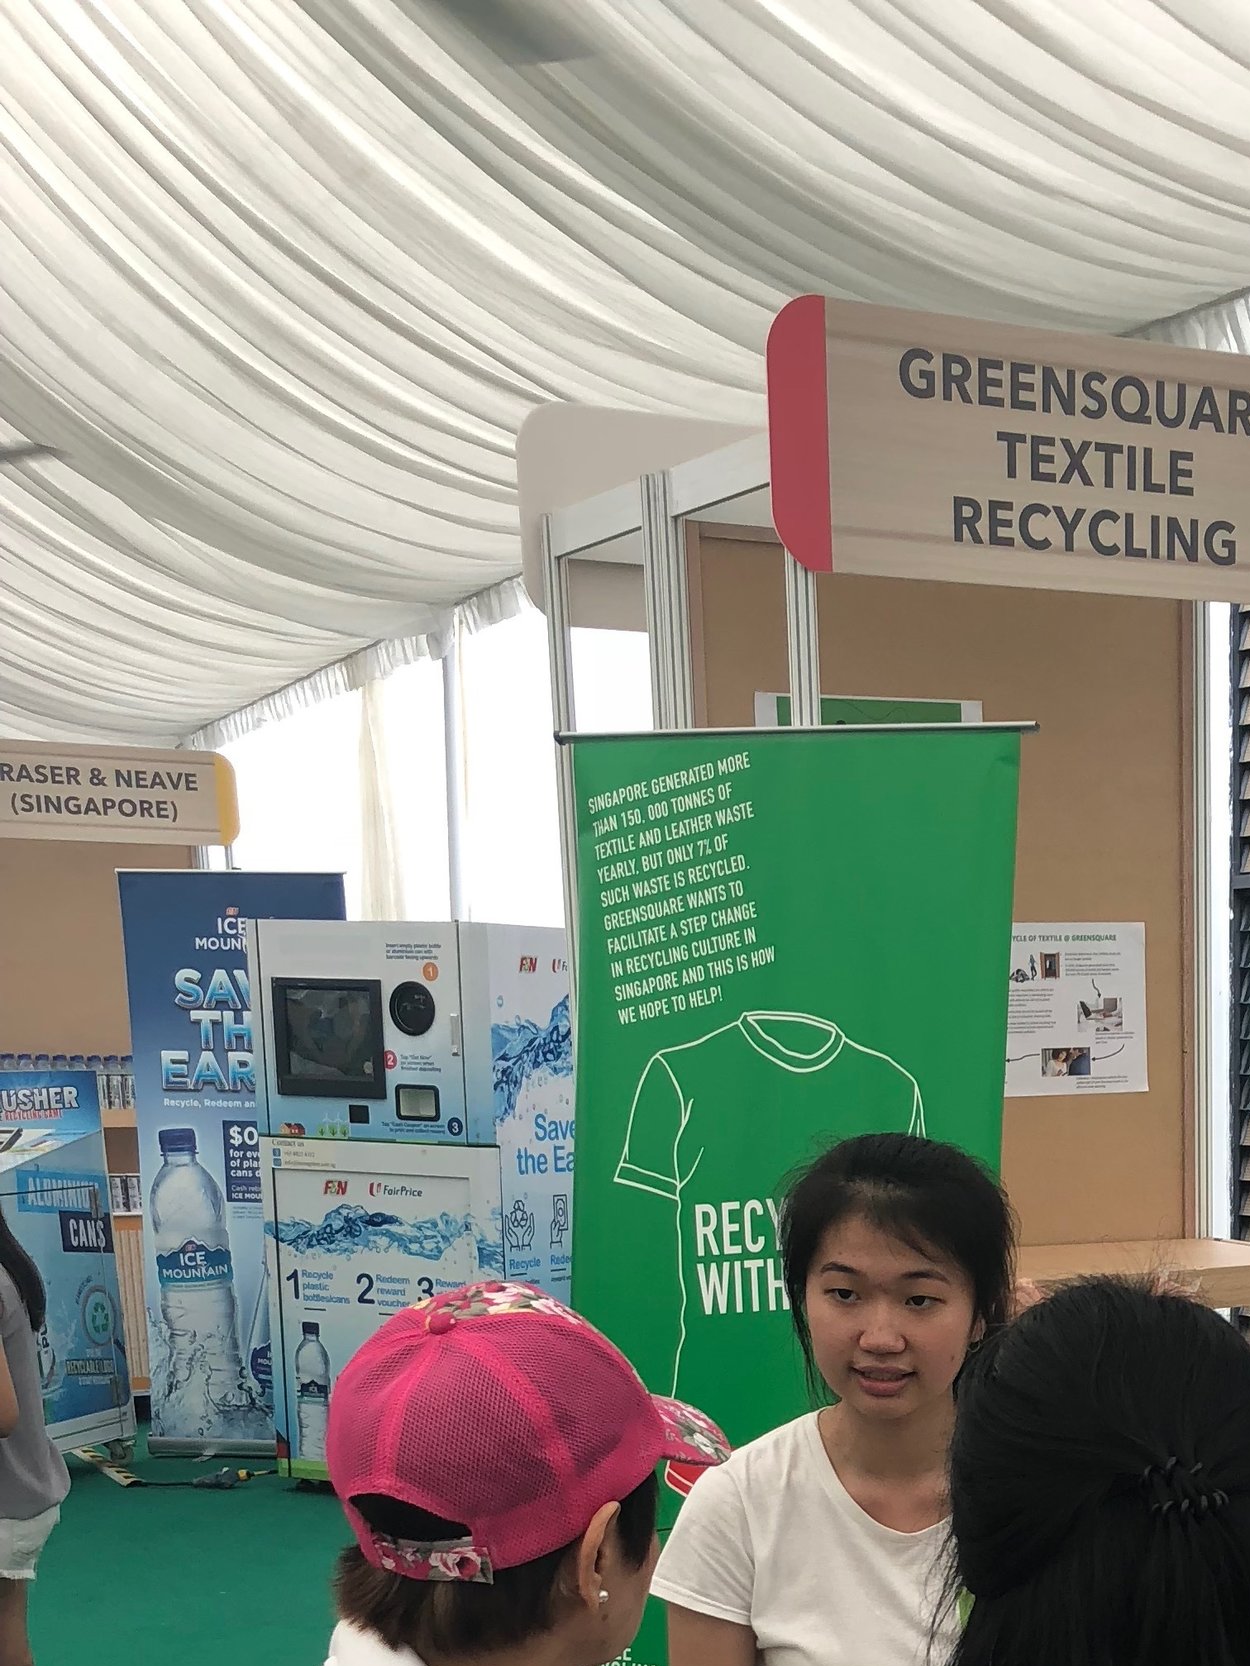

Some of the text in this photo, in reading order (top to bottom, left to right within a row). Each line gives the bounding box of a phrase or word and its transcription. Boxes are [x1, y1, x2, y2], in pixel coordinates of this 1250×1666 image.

[996, 431, 1195, 498] TEXTILE
[953, 495, 1238, 567] RECYCLING
[89, 767, 108, 787] &
[115, 769, 199, 792] NEAVE
[588, 751, 751, 815] SINGAPORE GENERATED MORE
[11, 792, 178, 823] (SINGAPORE)
[593, 814, 618, 838] THAN
[647, 800, 669, 821] 000
[671, 789, 715, 814] TONNES
[718, 781, 733, 800] OF
[594, 801, 754, 861] TEXTILE AND LEATHER WASTE
[642, 851, 663, 872] BUT
[667, 843, 694, 867] ONLY
[697, 838, 712, 857] 7%
[714, 833, 729, 852] OF
[600, 884, 630, 908] SUCH
[633, 875, 671, 899] WASTE
[674, 871, 685, 888] IS
[604, 880, 744, 932] GREENSQUARE WANTS TO
[607, 902, 758, 955] FACILITATE A STEP CHANGE
[1071, 934, 1117, 943] GREENSQUARE
[611, 926, 758, 979] IN RECYCLING CULTURE IN
[614, 946, 776, 1002] SINGAPORE AND THIS IS HOW
[618, 985, 724, 1026] WE HOPE TO HELP!
[387, 1054, 394, 1066] 2
[452, 1122, 459, 1133] 3
[229, 1149, 244, 1157] for
[230, 1159, 240, 1167] of
[516, 1147, 548, 1175] the
[230, 1169, 253, 1177] cans
[383, 1184, 423, 1197] FairPrice
[69, 1219, 106, 1248] CANS
[180, 1251, 207, 1266] ICE
[286, 1268, 334, 1300] 1 Recycle
[356, 1272, 376, 1304] 2
[696, 1258, 791, 1315] WITH
